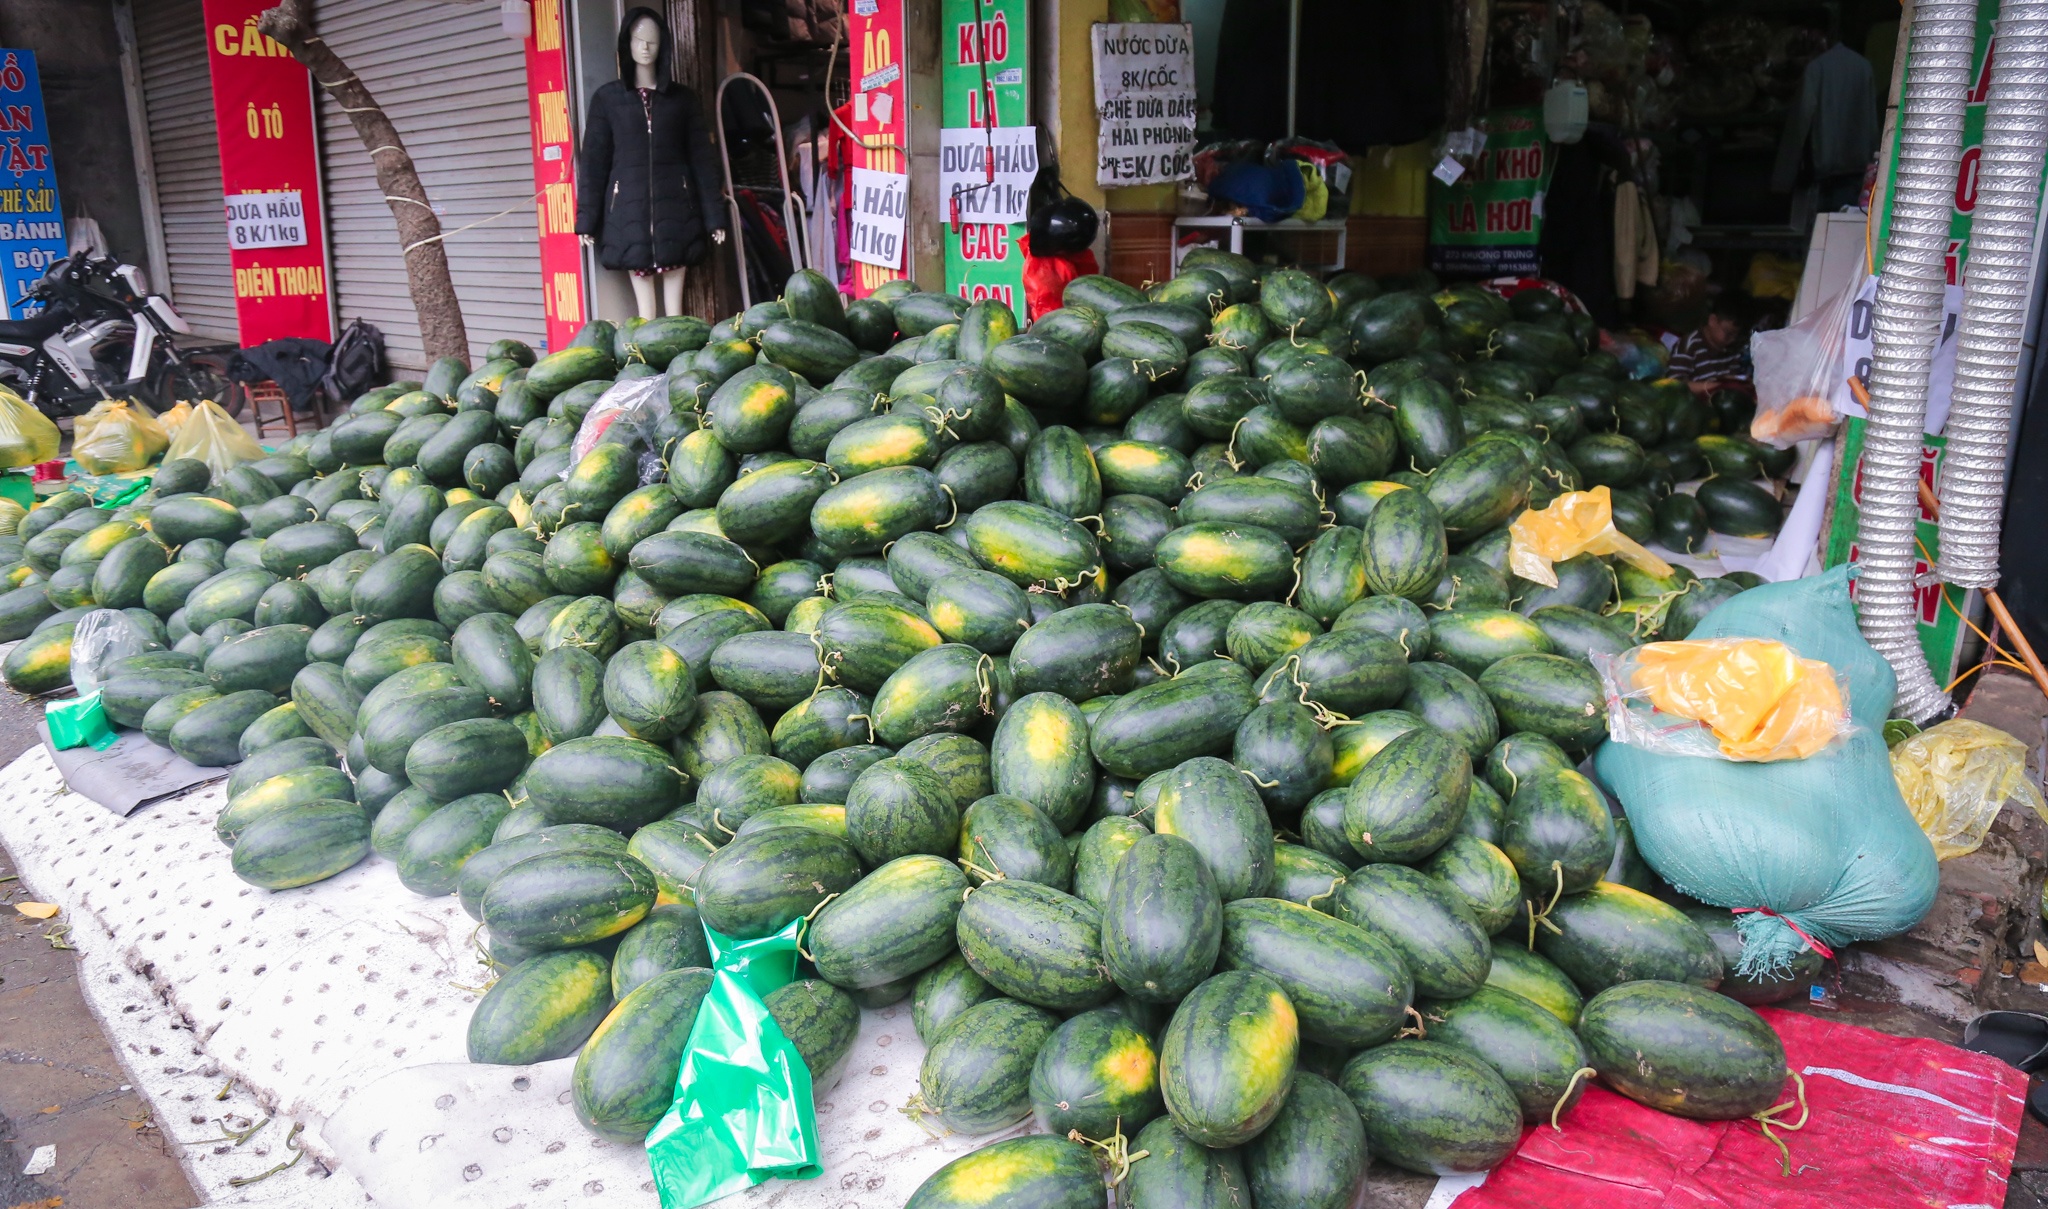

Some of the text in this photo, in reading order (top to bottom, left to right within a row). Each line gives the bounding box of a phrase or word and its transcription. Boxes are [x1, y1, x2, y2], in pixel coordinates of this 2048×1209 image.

[959, 10, 1008, 66] KHÔ
[1104, 35, 1189, 55] NƯỚC DỪA
[0, 52, 26, 92] Ồ
[1122, 64, 1177, 89] 8K/CỐC
[247, 102, 283, 139] Ô TÔ
[1104, 96, 1132, 119] CHÈ
[1137, 95, 1163, 118] DỪA
[1112, 120, 1191, 146] HẢI PHÒNG
[943, 142, 987, 173] DƯA
[1161, 146, 1191, 177] CỐC
[1496, 141, 1542, 181] KHÔ
[26, 179, 55, 213] SẦU
[227, 196, 301, 221] DƯA HẤU
[863, 180, 906, 219] HẤU
[0, 219, 62, 240] BÁNH
[1448, 197, 1532, 232] LÀ HƠI
[13, 247, 56, 271] BỘT
[236, 262, 323, 304] ĐIỆN THOẠI
